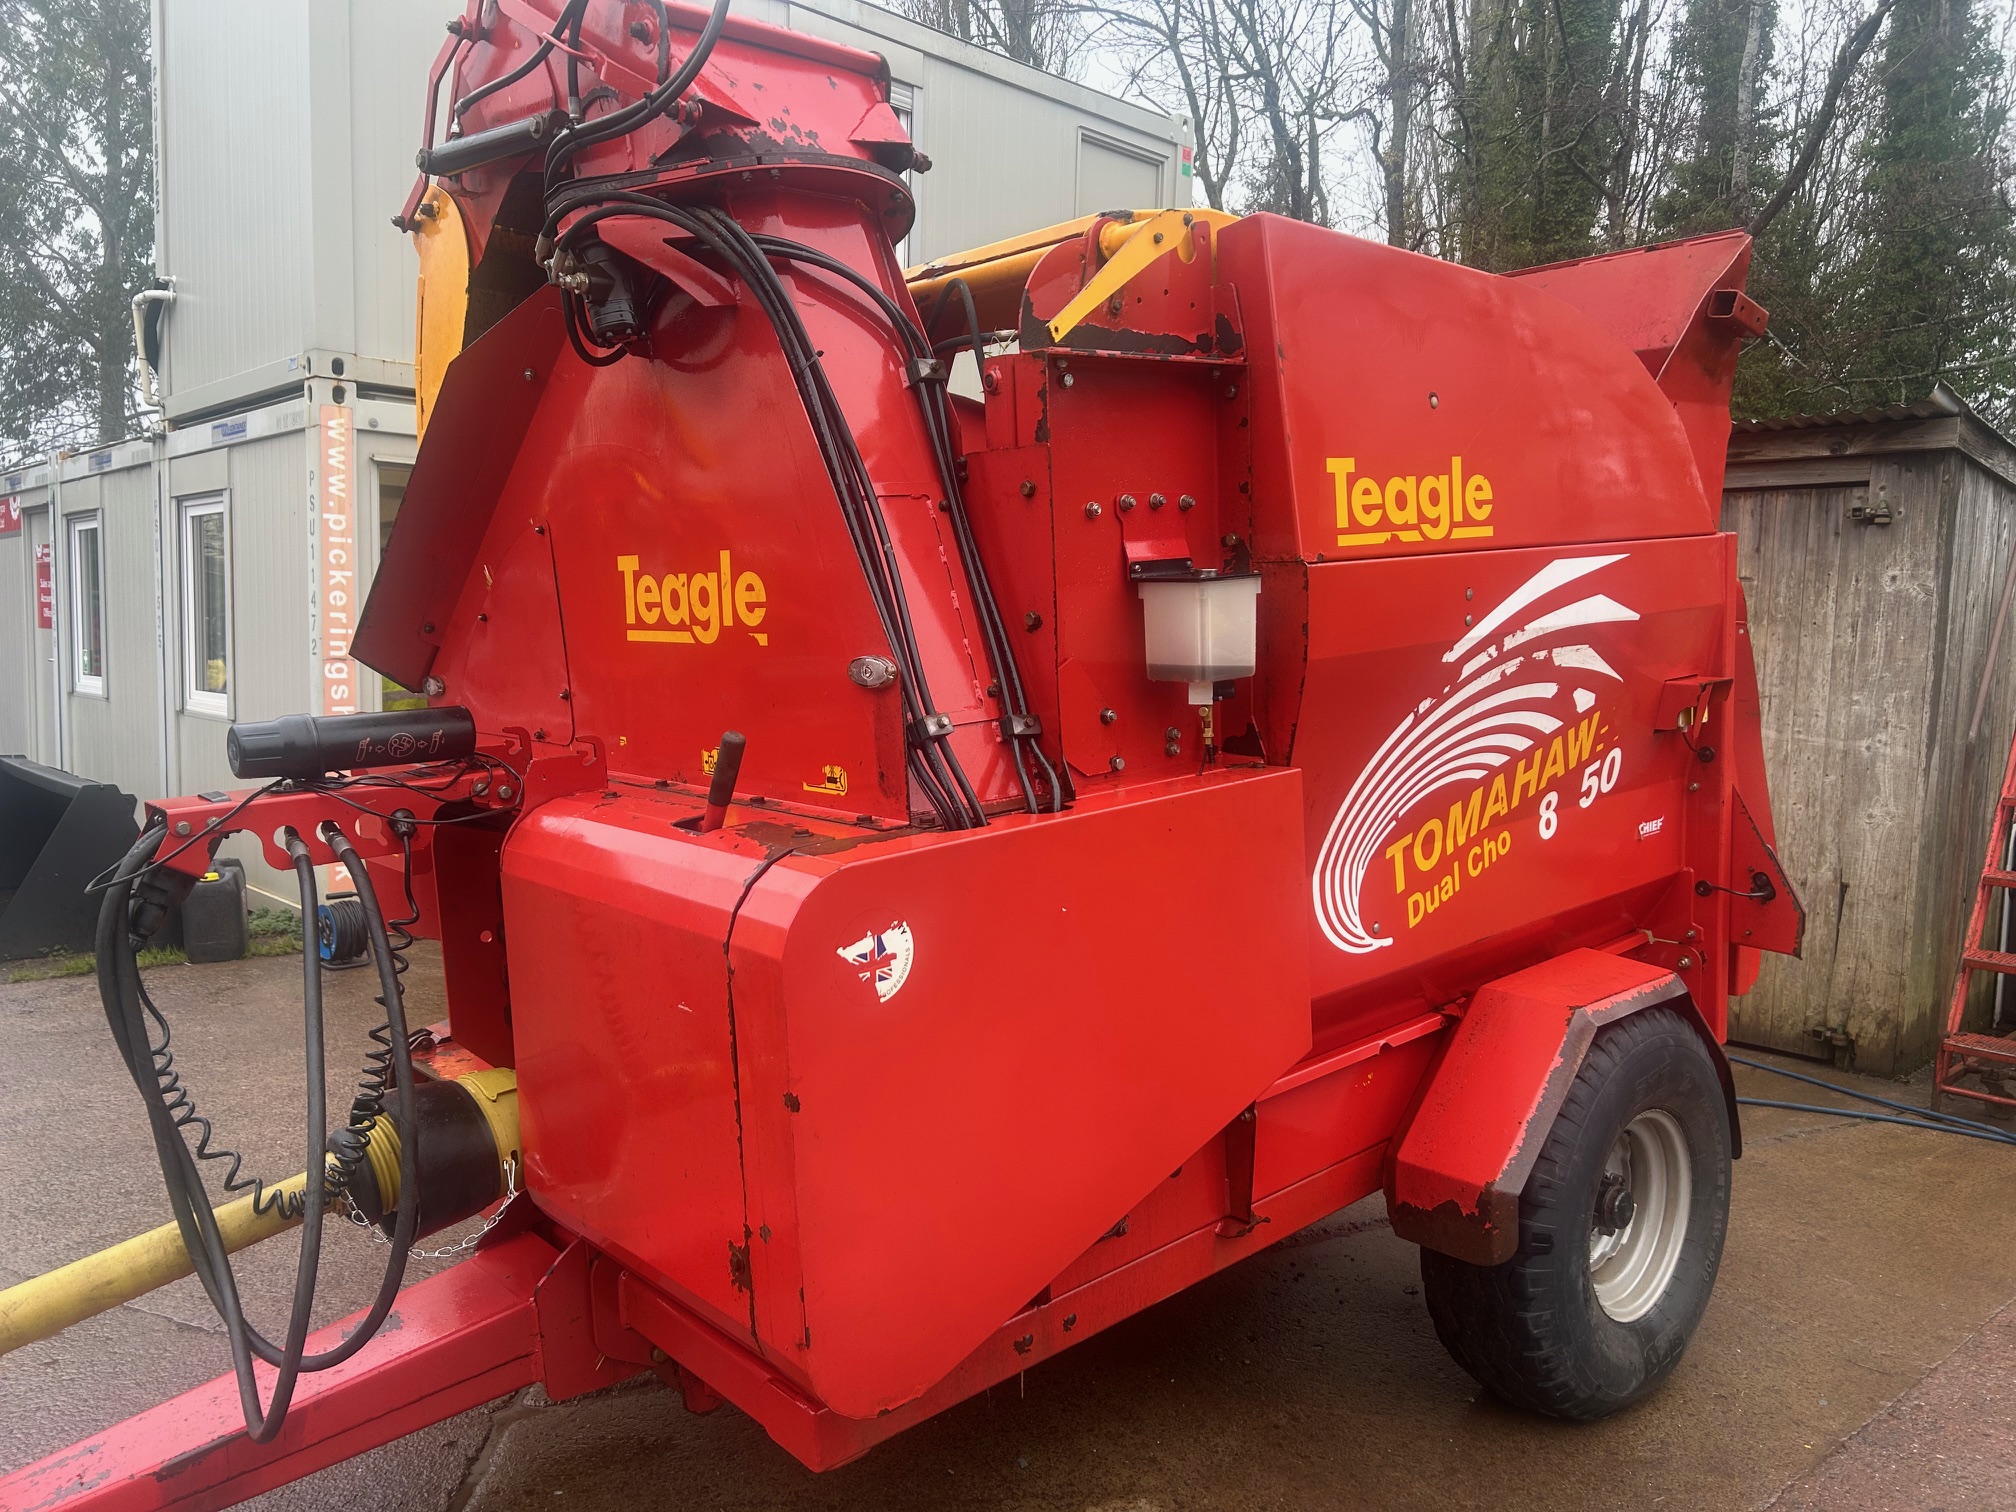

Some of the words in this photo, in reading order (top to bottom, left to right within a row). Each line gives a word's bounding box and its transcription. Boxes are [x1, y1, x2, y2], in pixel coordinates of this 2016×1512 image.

[1326, 456, 1493, 540] Teagle
[308, 470, 318, 656] PSU11472
[617, 549, 767, 644] Teagle
[1385, 711, 1609, 893] TOMAHAW
[1639, 815, 1664, 835] CHIEF
[1407, 869, 1460, 929] Dual
